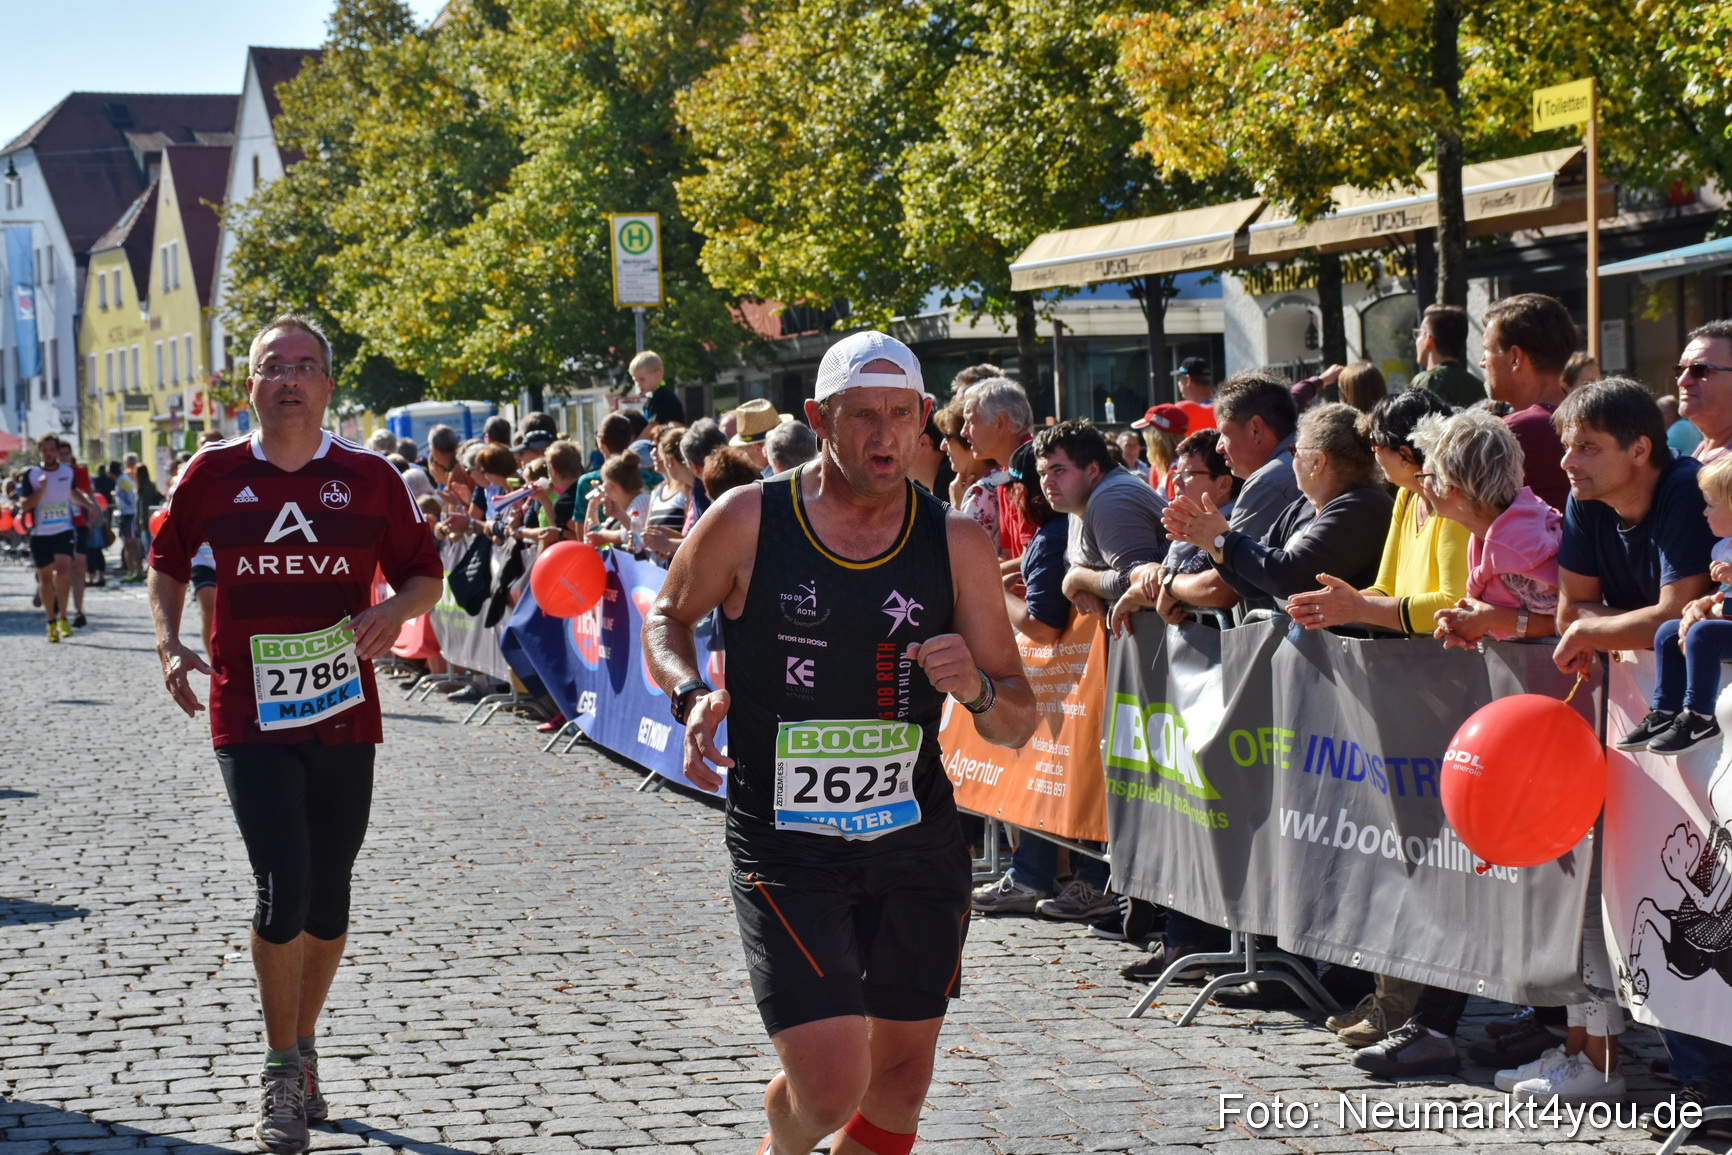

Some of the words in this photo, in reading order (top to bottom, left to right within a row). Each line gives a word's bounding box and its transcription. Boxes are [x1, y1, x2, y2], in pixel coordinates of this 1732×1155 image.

[1544, 95, 1588, 117] Toiletten
[627, 228, 644, 248] H
[323, 492, 348, 503] FCN
[331, 482, 340, 493] 1.
[233, 496, 259, 504] adidas
[236, 555, 350, 576] AREVA
[780, 593, 793, 601] TSG
[794, 594, 803, 602] 08
[797, 607, 817, 617] ROTH
[261, 628, 349, 660] BOCK
[876, 643, 896, 681] ROTH
[1046, 662, 1065, 677] und
[267, 652, 350, 697] 2786
[279, 683, 350, 718] MAREK
[877, 687, 895, 706] 08
[790, 726, 906, 752] BOCK
[1109, 697, 1212, 795] BOK
[950, 749, 1004, 787] Agentur
[1303, 734, 1444, 798] INDUSTR
[1452, 763, 1482, 777] energie
[793, 762, 902, 804] 2623
[1053, 782, 1067, 798] 897
